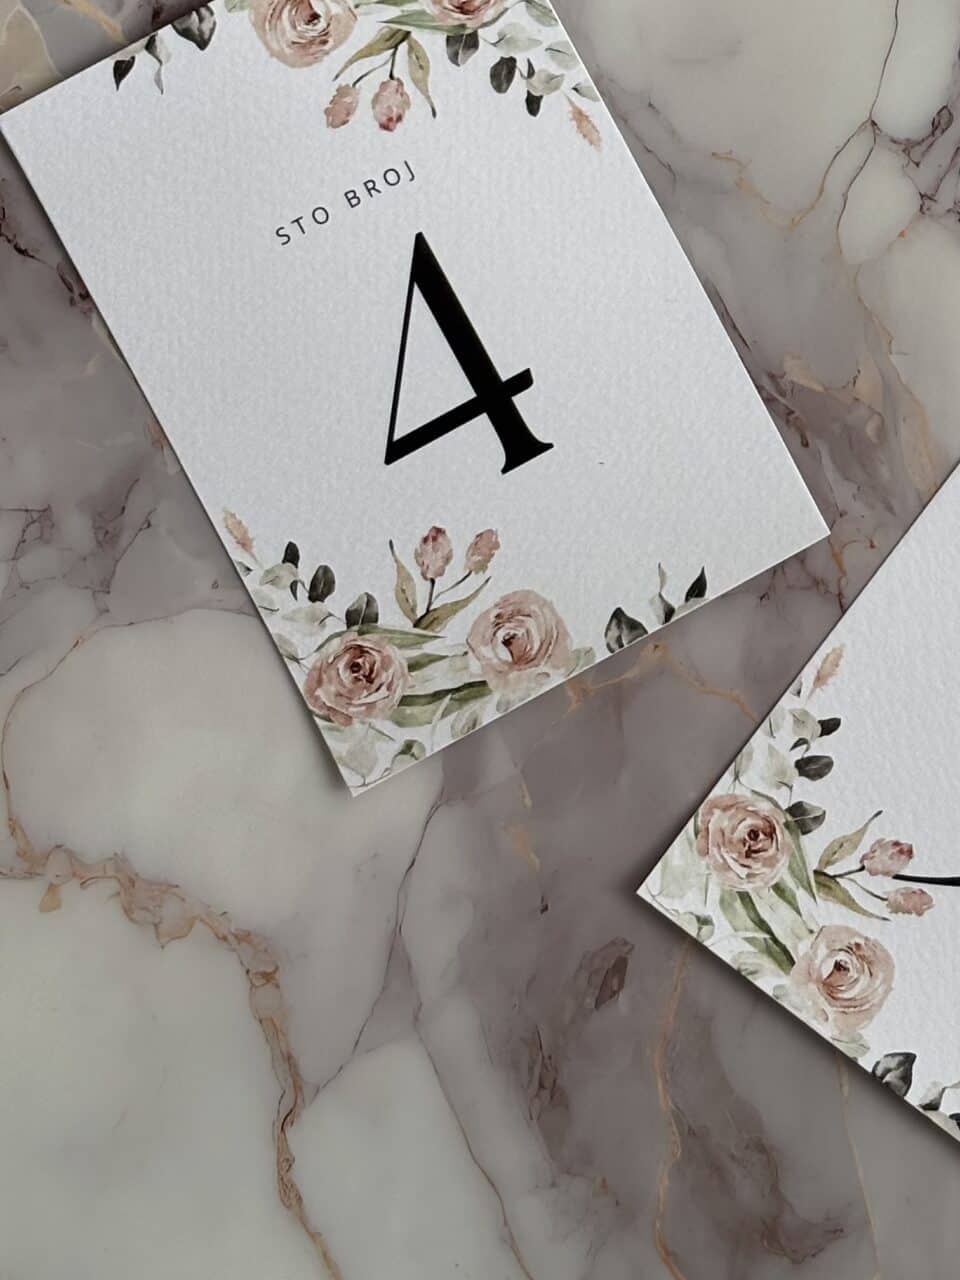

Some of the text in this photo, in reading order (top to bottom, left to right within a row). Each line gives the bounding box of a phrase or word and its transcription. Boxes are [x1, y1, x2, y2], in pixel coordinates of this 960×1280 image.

[275, 160, 416, 246] STO BROJ
[383, 231, 554, 475] 4
